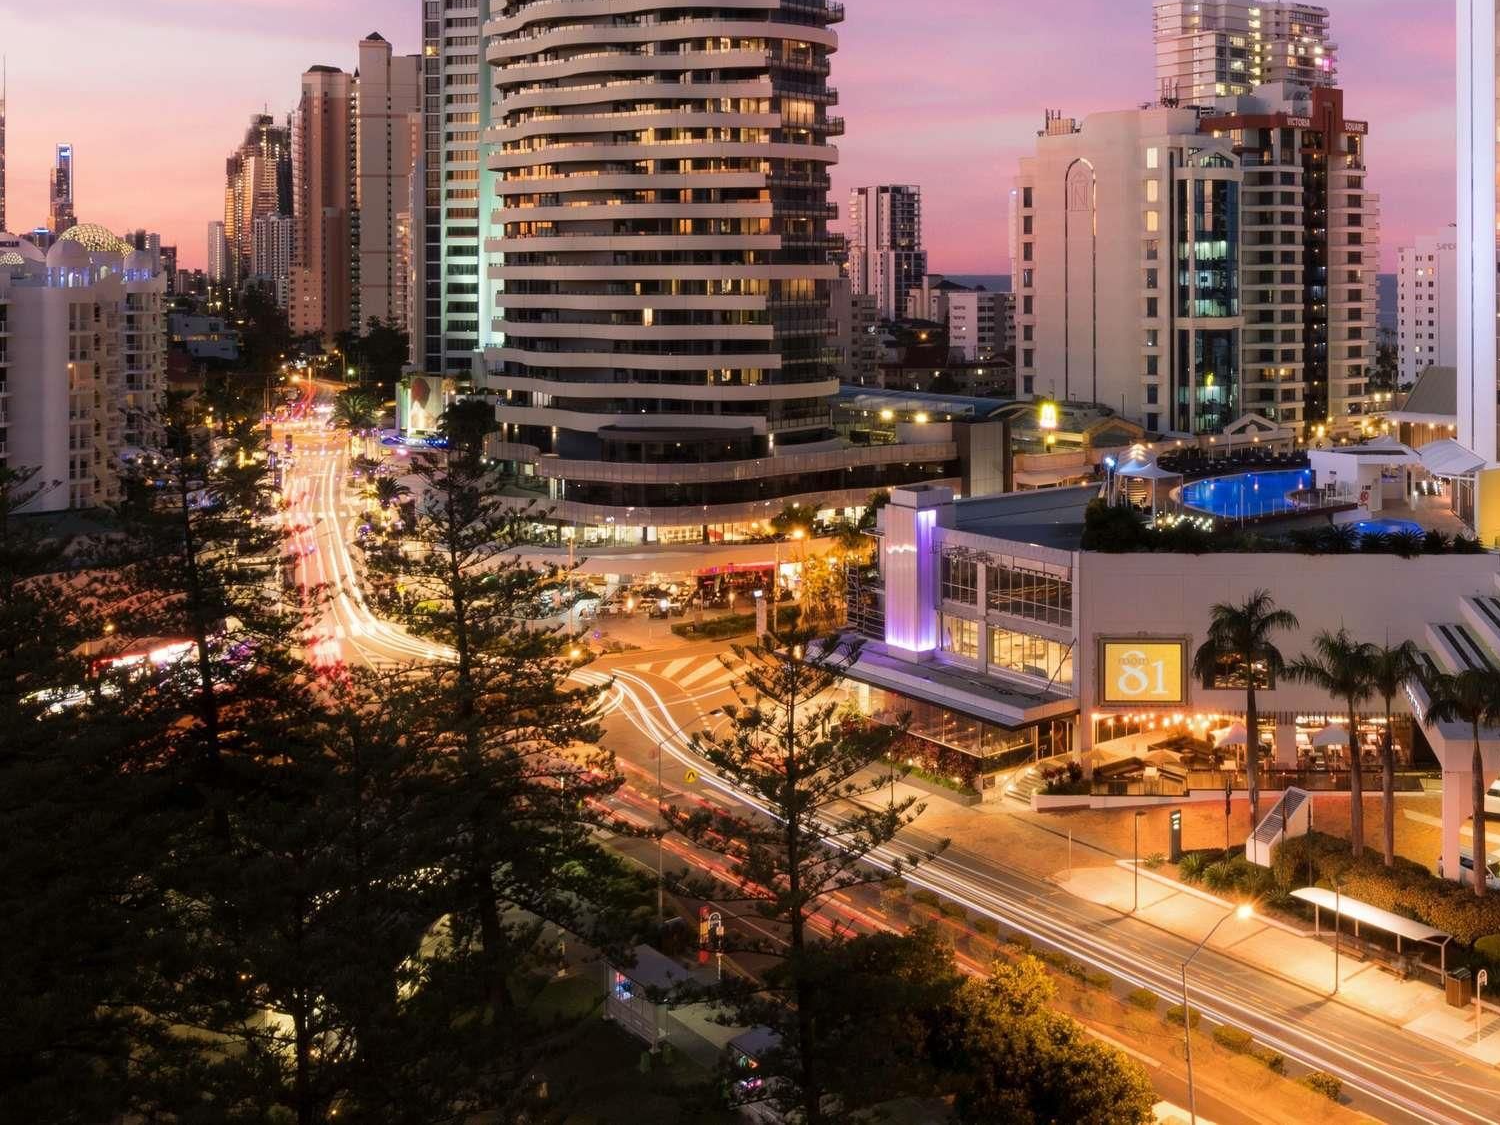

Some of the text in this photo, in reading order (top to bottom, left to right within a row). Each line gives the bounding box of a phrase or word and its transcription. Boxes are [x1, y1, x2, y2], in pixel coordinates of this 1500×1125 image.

[1287, 117, 1365, 132] VICTORIA SQUARE
[1118, 650, 1169, 696] 81
